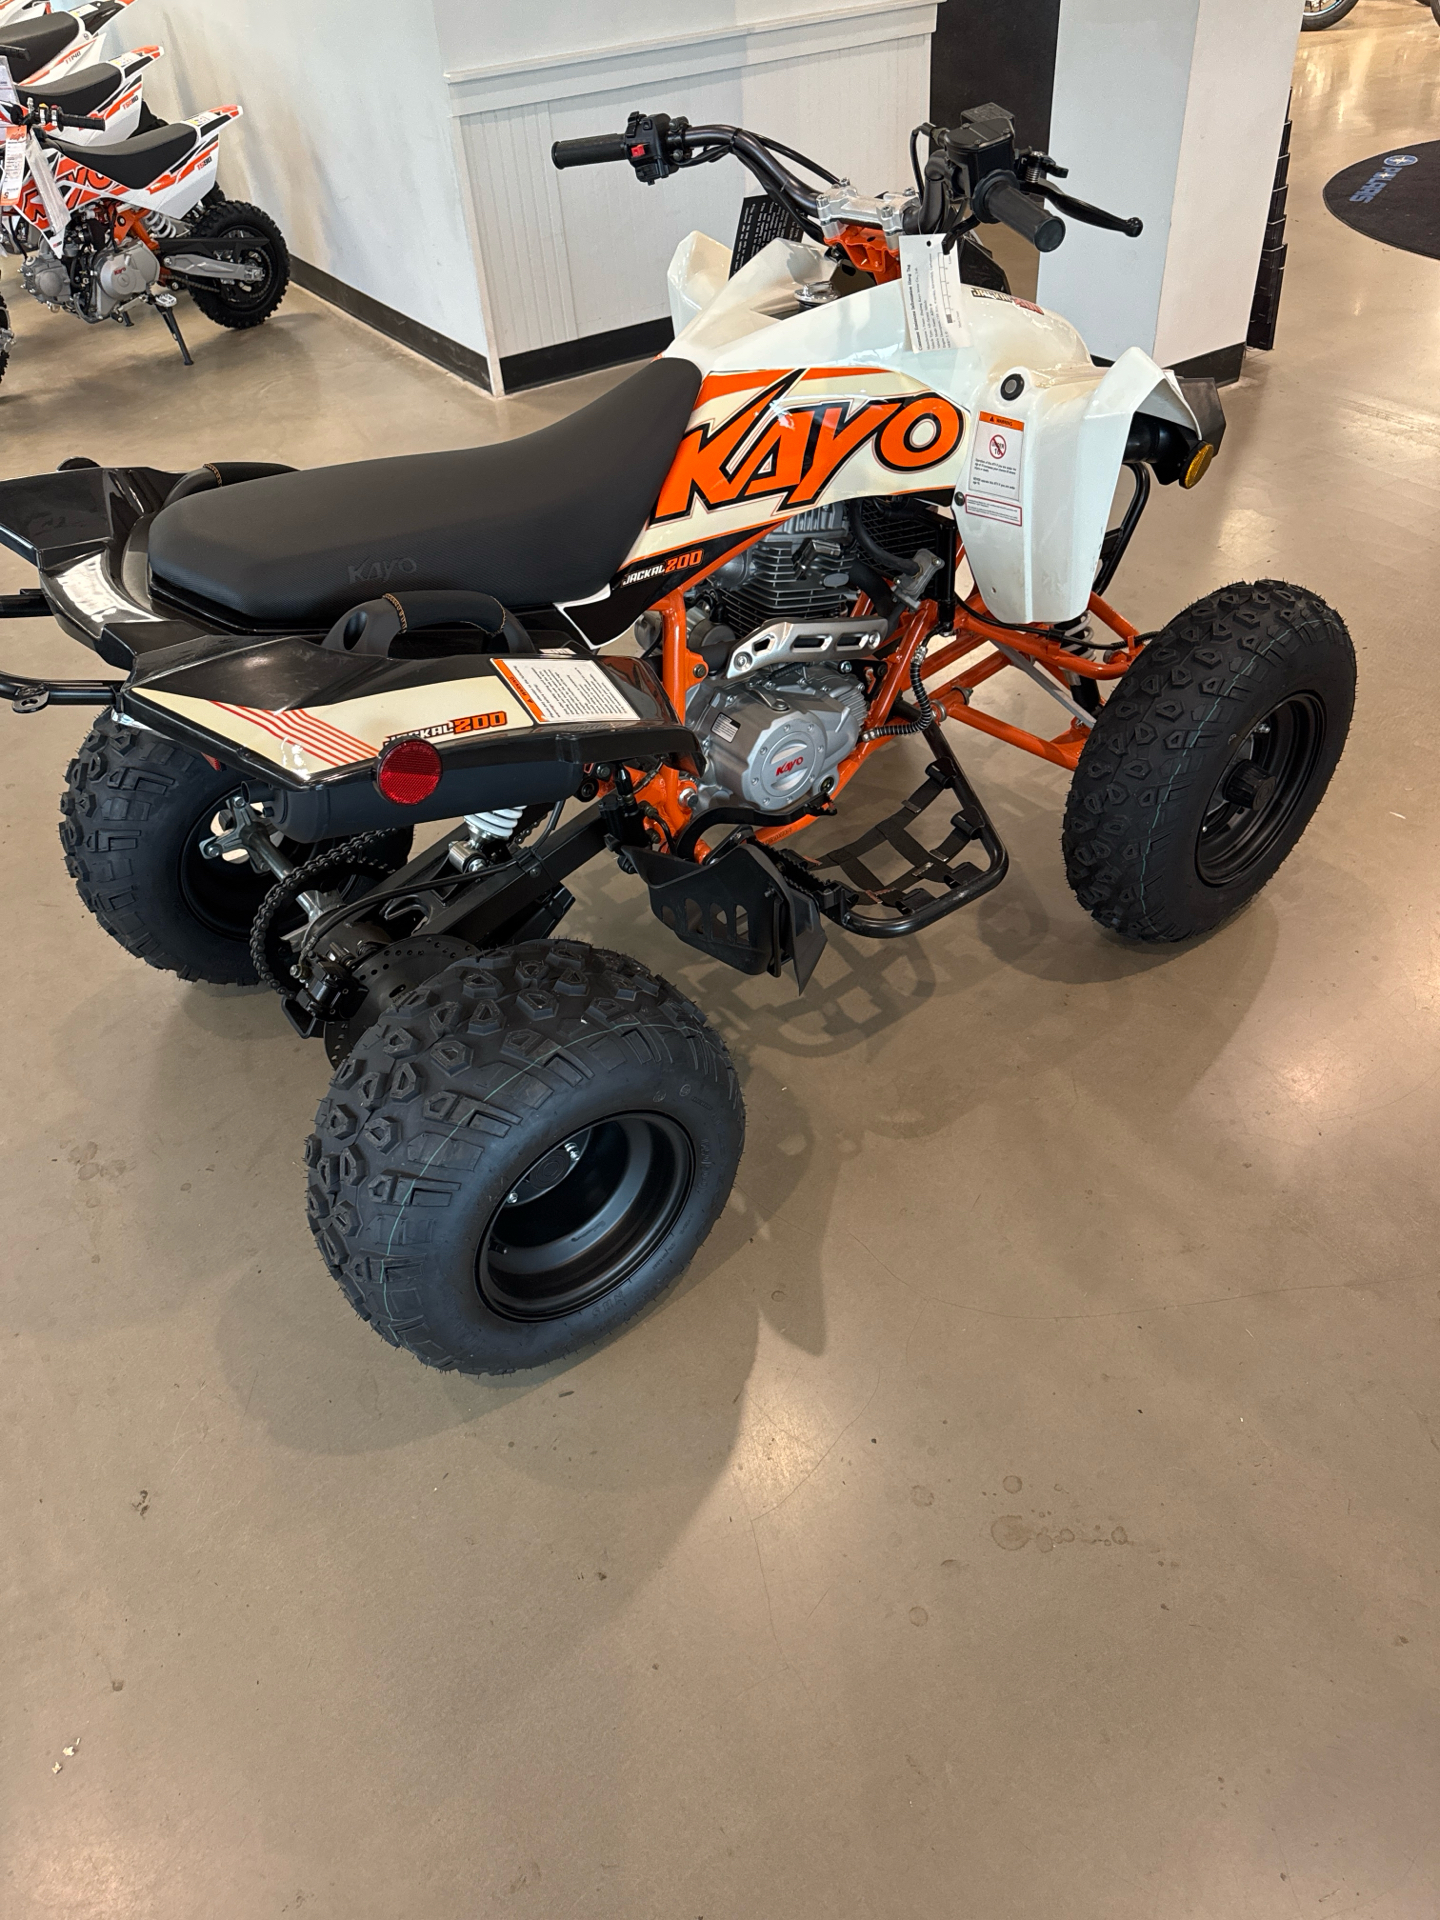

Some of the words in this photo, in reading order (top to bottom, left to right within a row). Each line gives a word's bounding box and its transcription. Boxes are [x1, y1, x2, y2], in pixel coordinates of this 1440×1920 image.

[1349, 167, 1402, 203] POLARIS
[643, 370, 963, 525] KAYO
[348, 556, 417, 584] KAYO
[622, 564, 666, 586] JACKAL
[664, 550, 703, 574] 200
[453, 711, 507, 734] 200
[775, 757, 804, 776] KAYO
